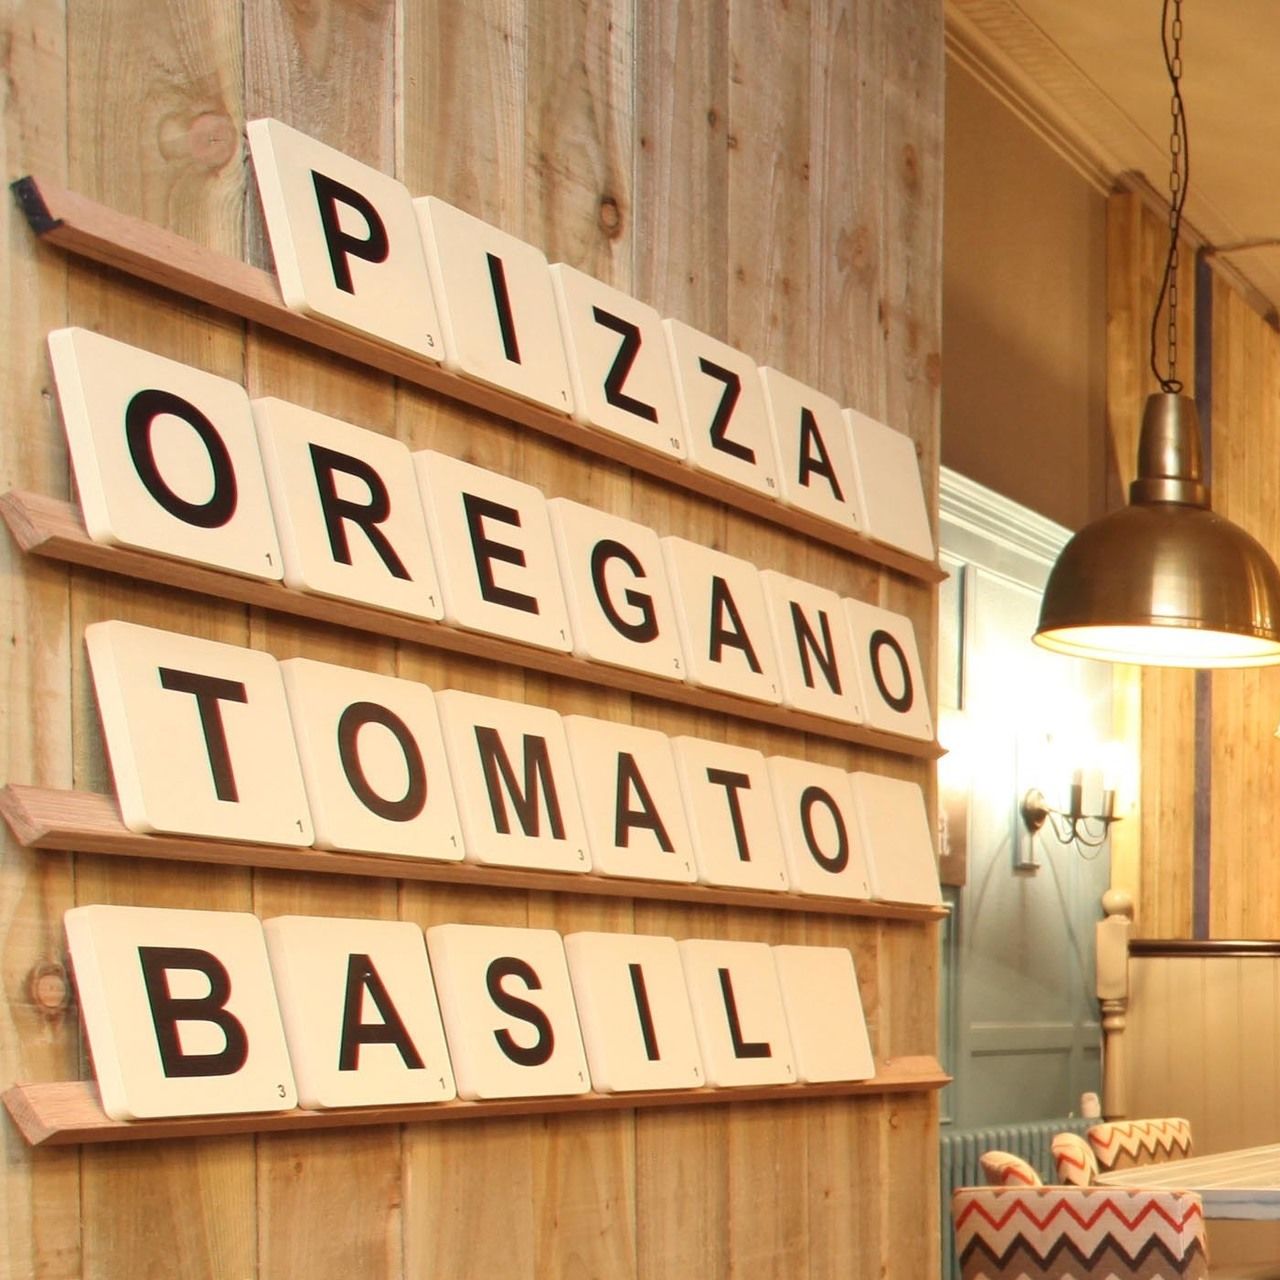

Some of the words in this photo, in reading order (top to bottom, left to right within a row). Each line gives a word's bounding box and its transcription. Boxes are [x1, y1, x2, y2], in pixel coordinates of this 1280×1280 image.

[311, 170, 845, 502] PIZZA
[125, 389, 913, 712] OREGANO
[159, 667, 849, 873] TOMATO
[137, 946, 772, 1078] BASIL
